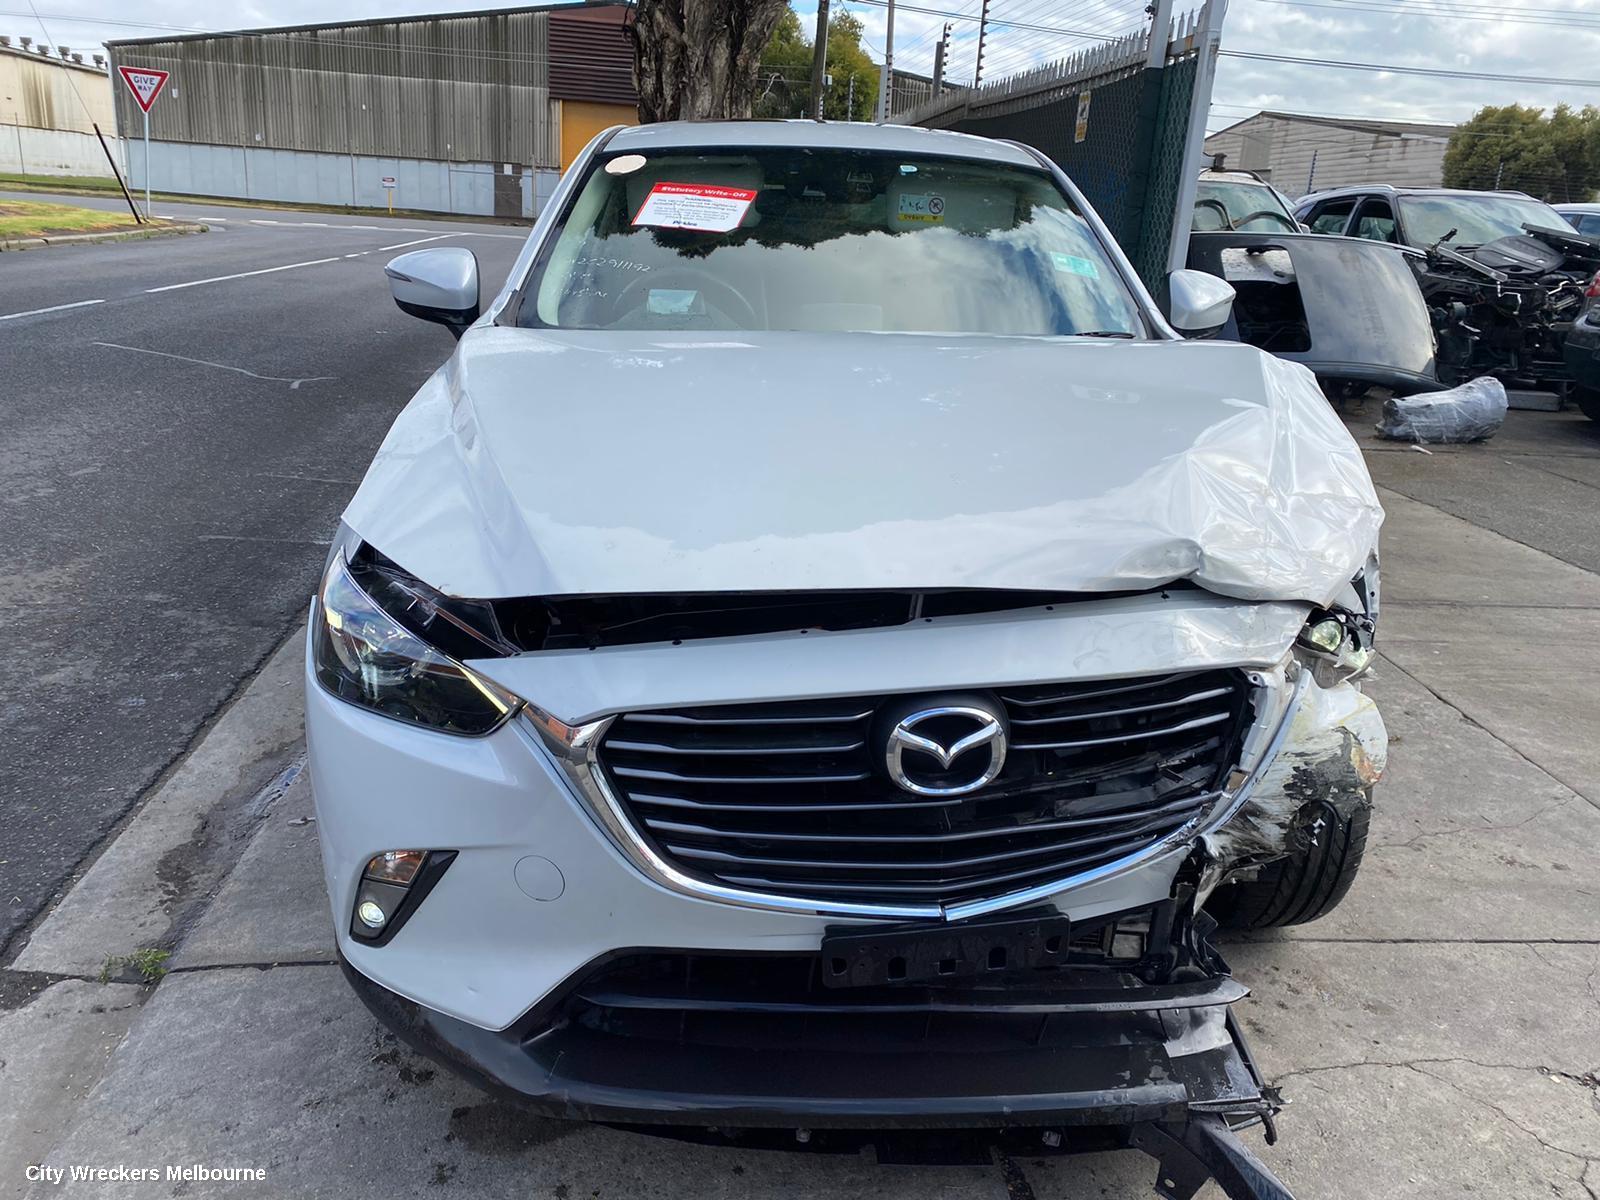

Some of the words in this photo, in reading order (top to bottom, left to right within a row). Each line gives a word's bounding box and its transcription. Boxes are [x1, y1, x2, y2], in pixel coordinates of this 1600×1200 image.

[134, 76, 155, 85] GIVE
[661, 186, 703, 195] Statutory
[704, 189, 748, 198] Write-Off
